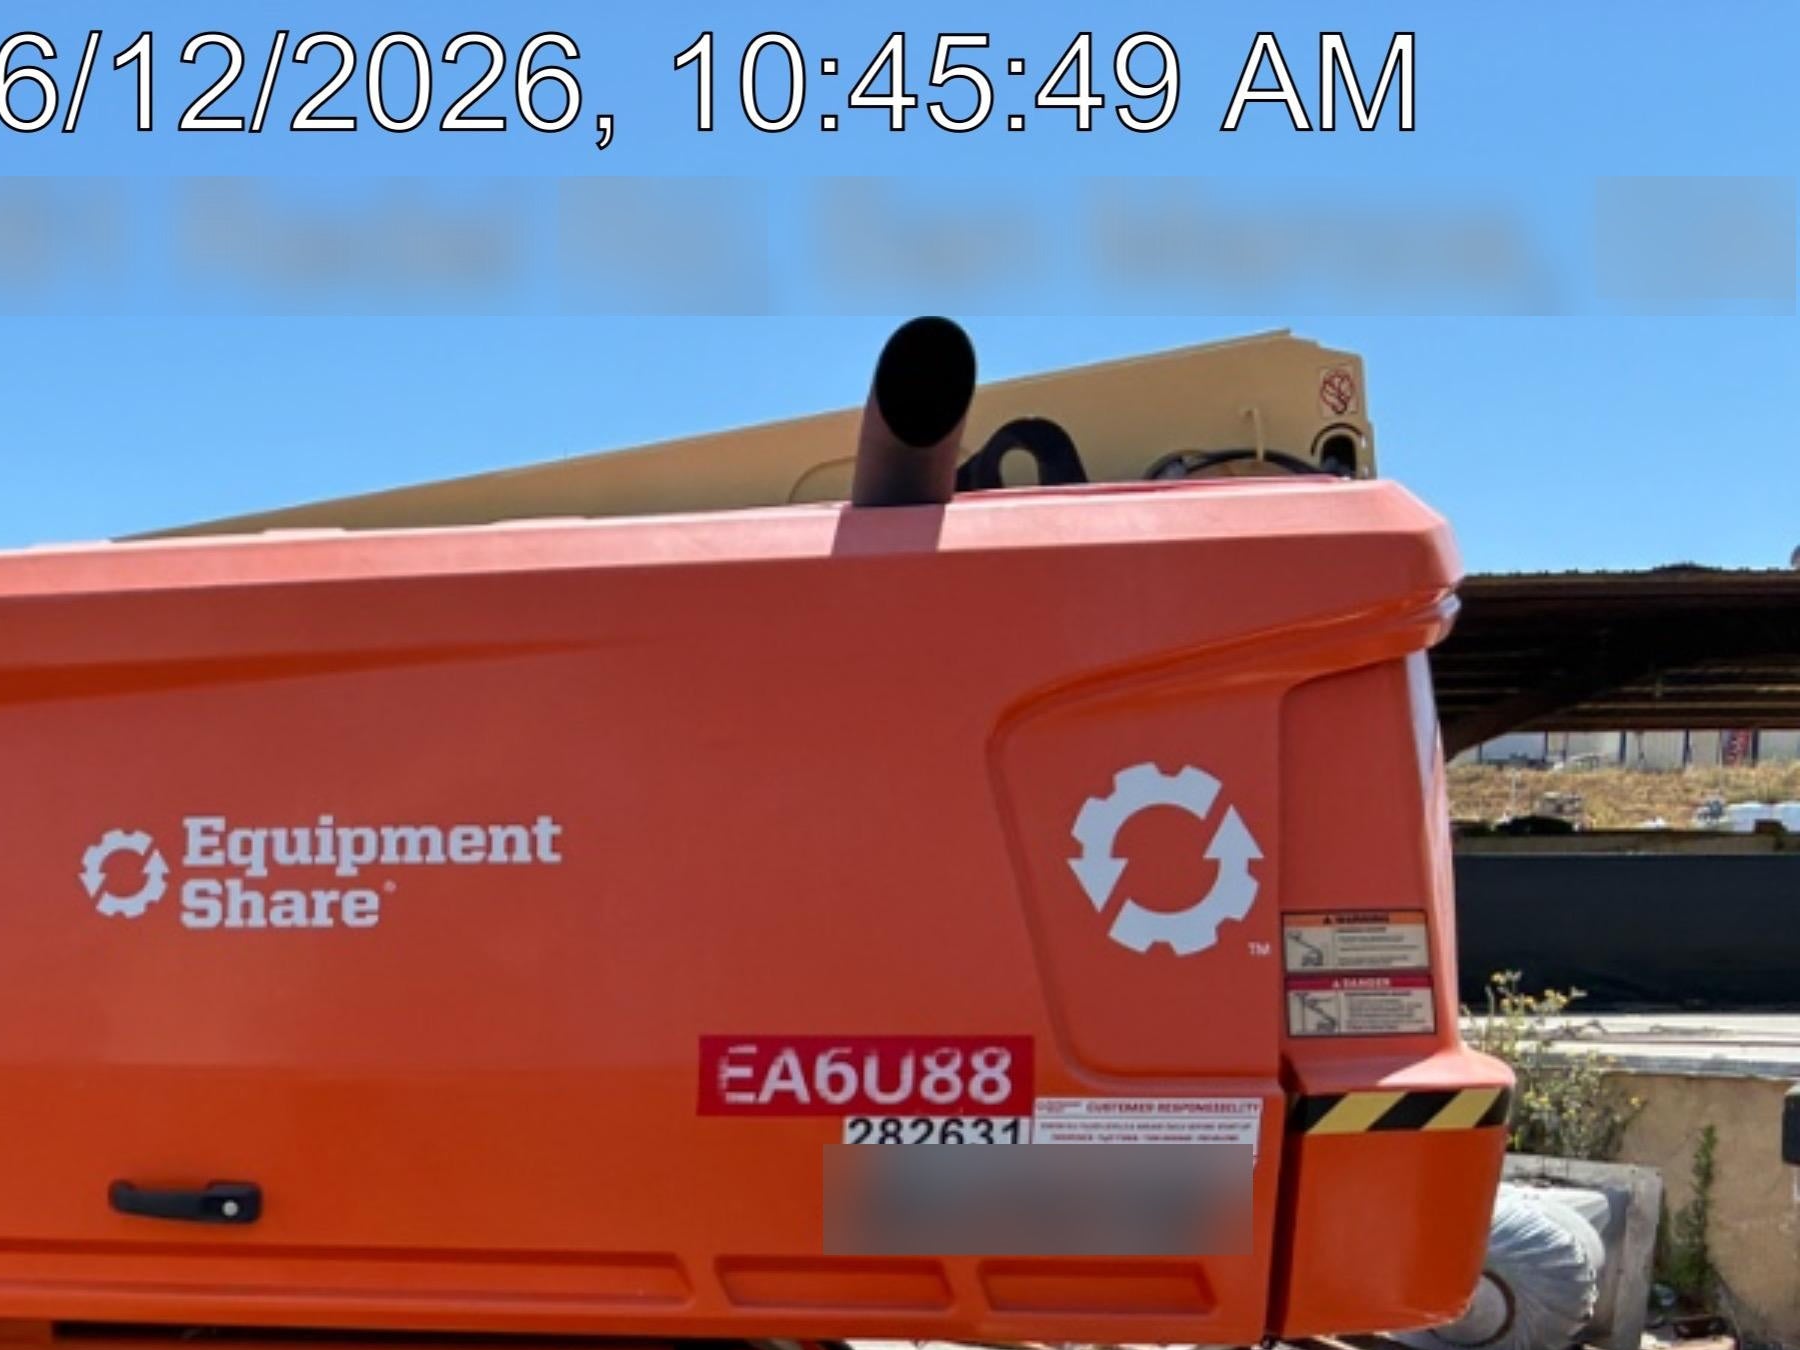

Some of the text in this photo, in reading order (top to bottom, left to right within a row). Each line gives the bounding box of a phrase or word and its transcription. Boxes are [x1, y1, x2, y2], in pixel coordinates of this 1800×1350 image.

[182, 814, 562, 877] Equipment
[181, 878, 380, 929] Share
[719, 1043, 1012, 1105] EA6U88
